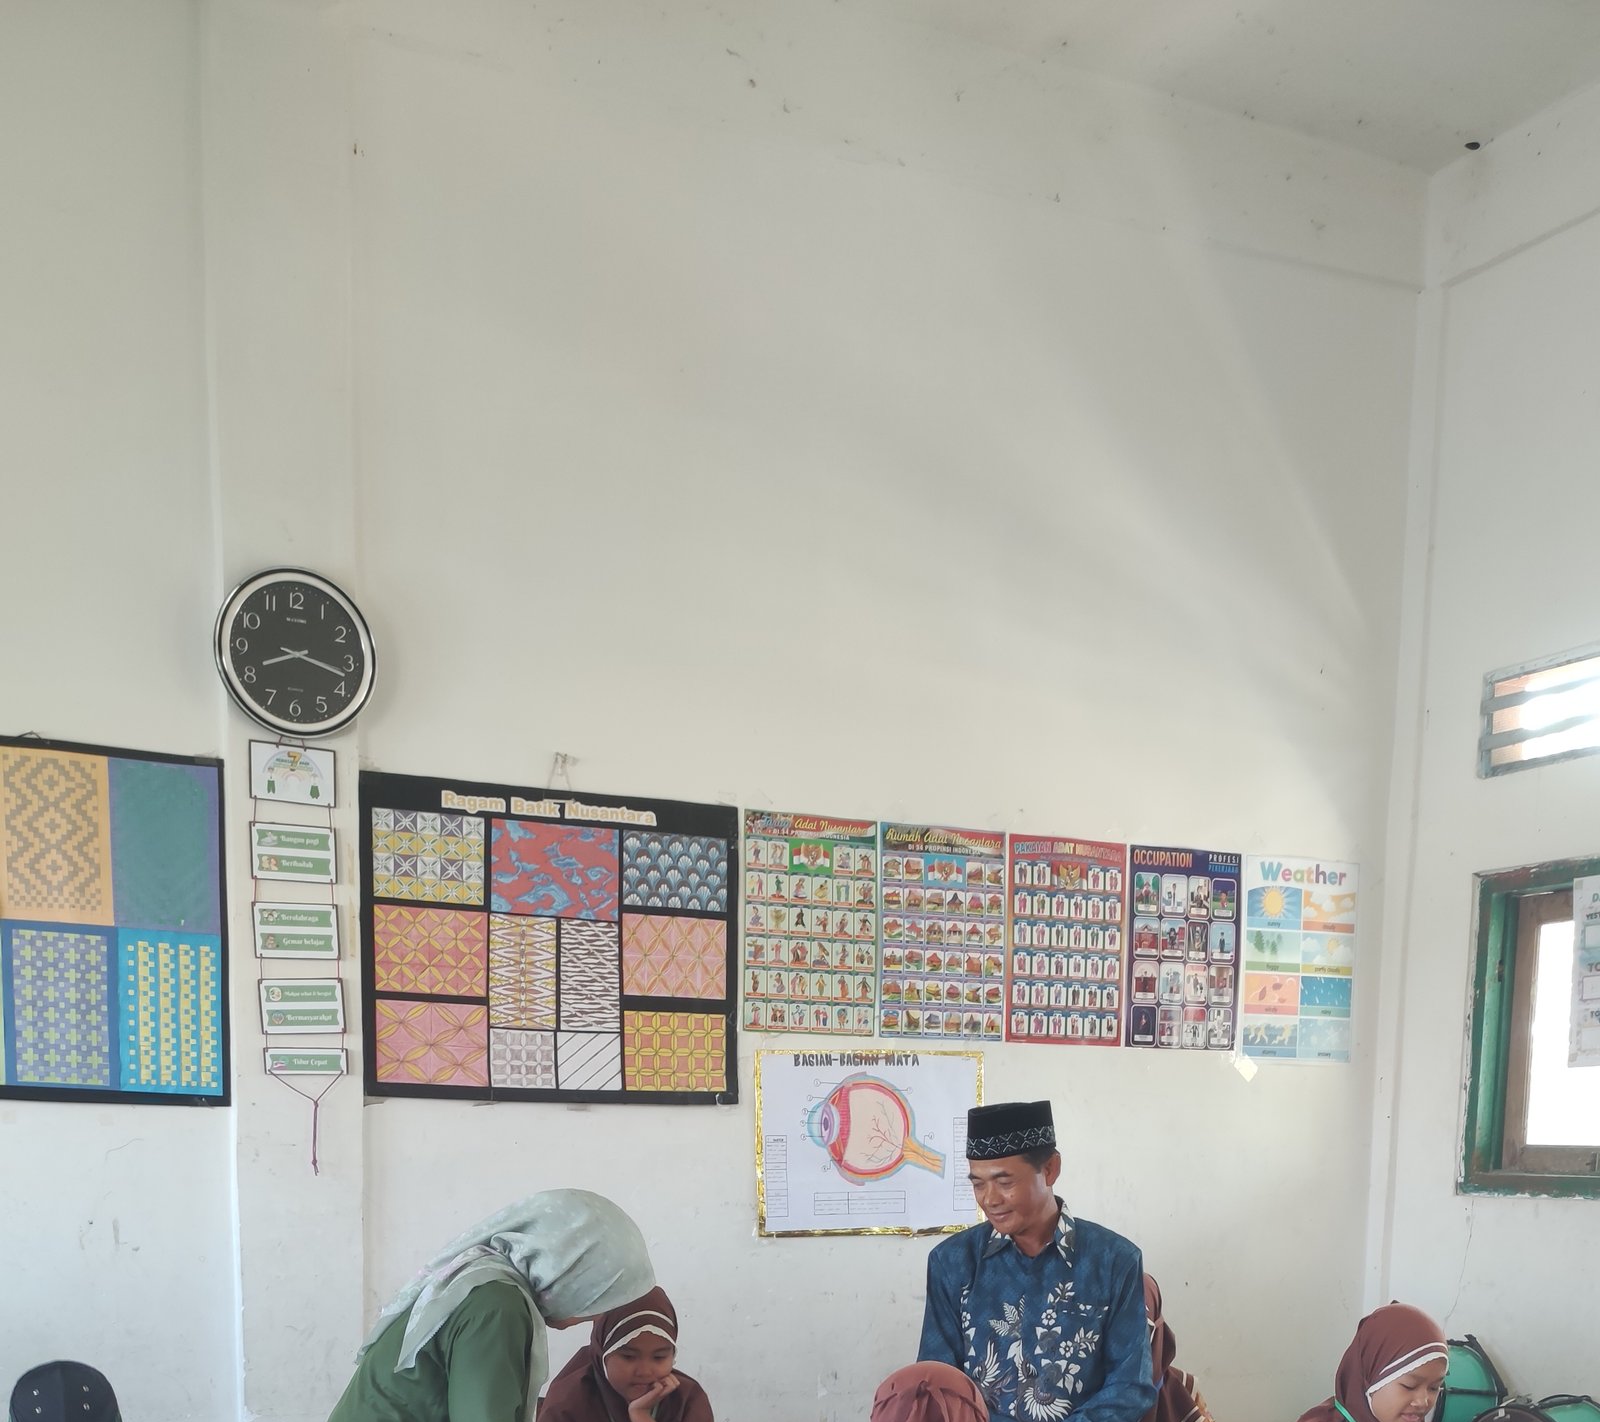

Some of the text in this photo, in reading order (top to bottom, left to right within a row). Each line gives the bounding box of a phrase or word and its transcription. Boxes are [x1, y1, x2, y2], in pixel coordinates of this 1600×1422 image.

[266, 594, 276, 611] 11
[289, 592, 304, 610] 12
[321, 604, 325, 620] 1
[243, 612, 260, 630] 10
[334, 625, 347, 643] 2
[236, 637, 248, 655] 9
[342, 654, 355, 672] 3
[244, 666, 257, 683] 8
[265, 688, 277, 705] 7
[333, 681, 346, 698] 4
[289, 699, 302, 717] 6
[315, 696, 328, 713] 5
[442, 790, 656, 825] Ragam Batik Nusantara
[886, 828, 920, 841] Rumah
[924, 831, 948, 844] Adat
[1053, 842, 1075, 854] ADAT
[1133, 849, 1193, 868] OCCUPATION
[1208, 854, 1240, 864] PROFESI
[1260, 861, 1347, 886] Weather
[884, 1053, 920, 1066] MATA
